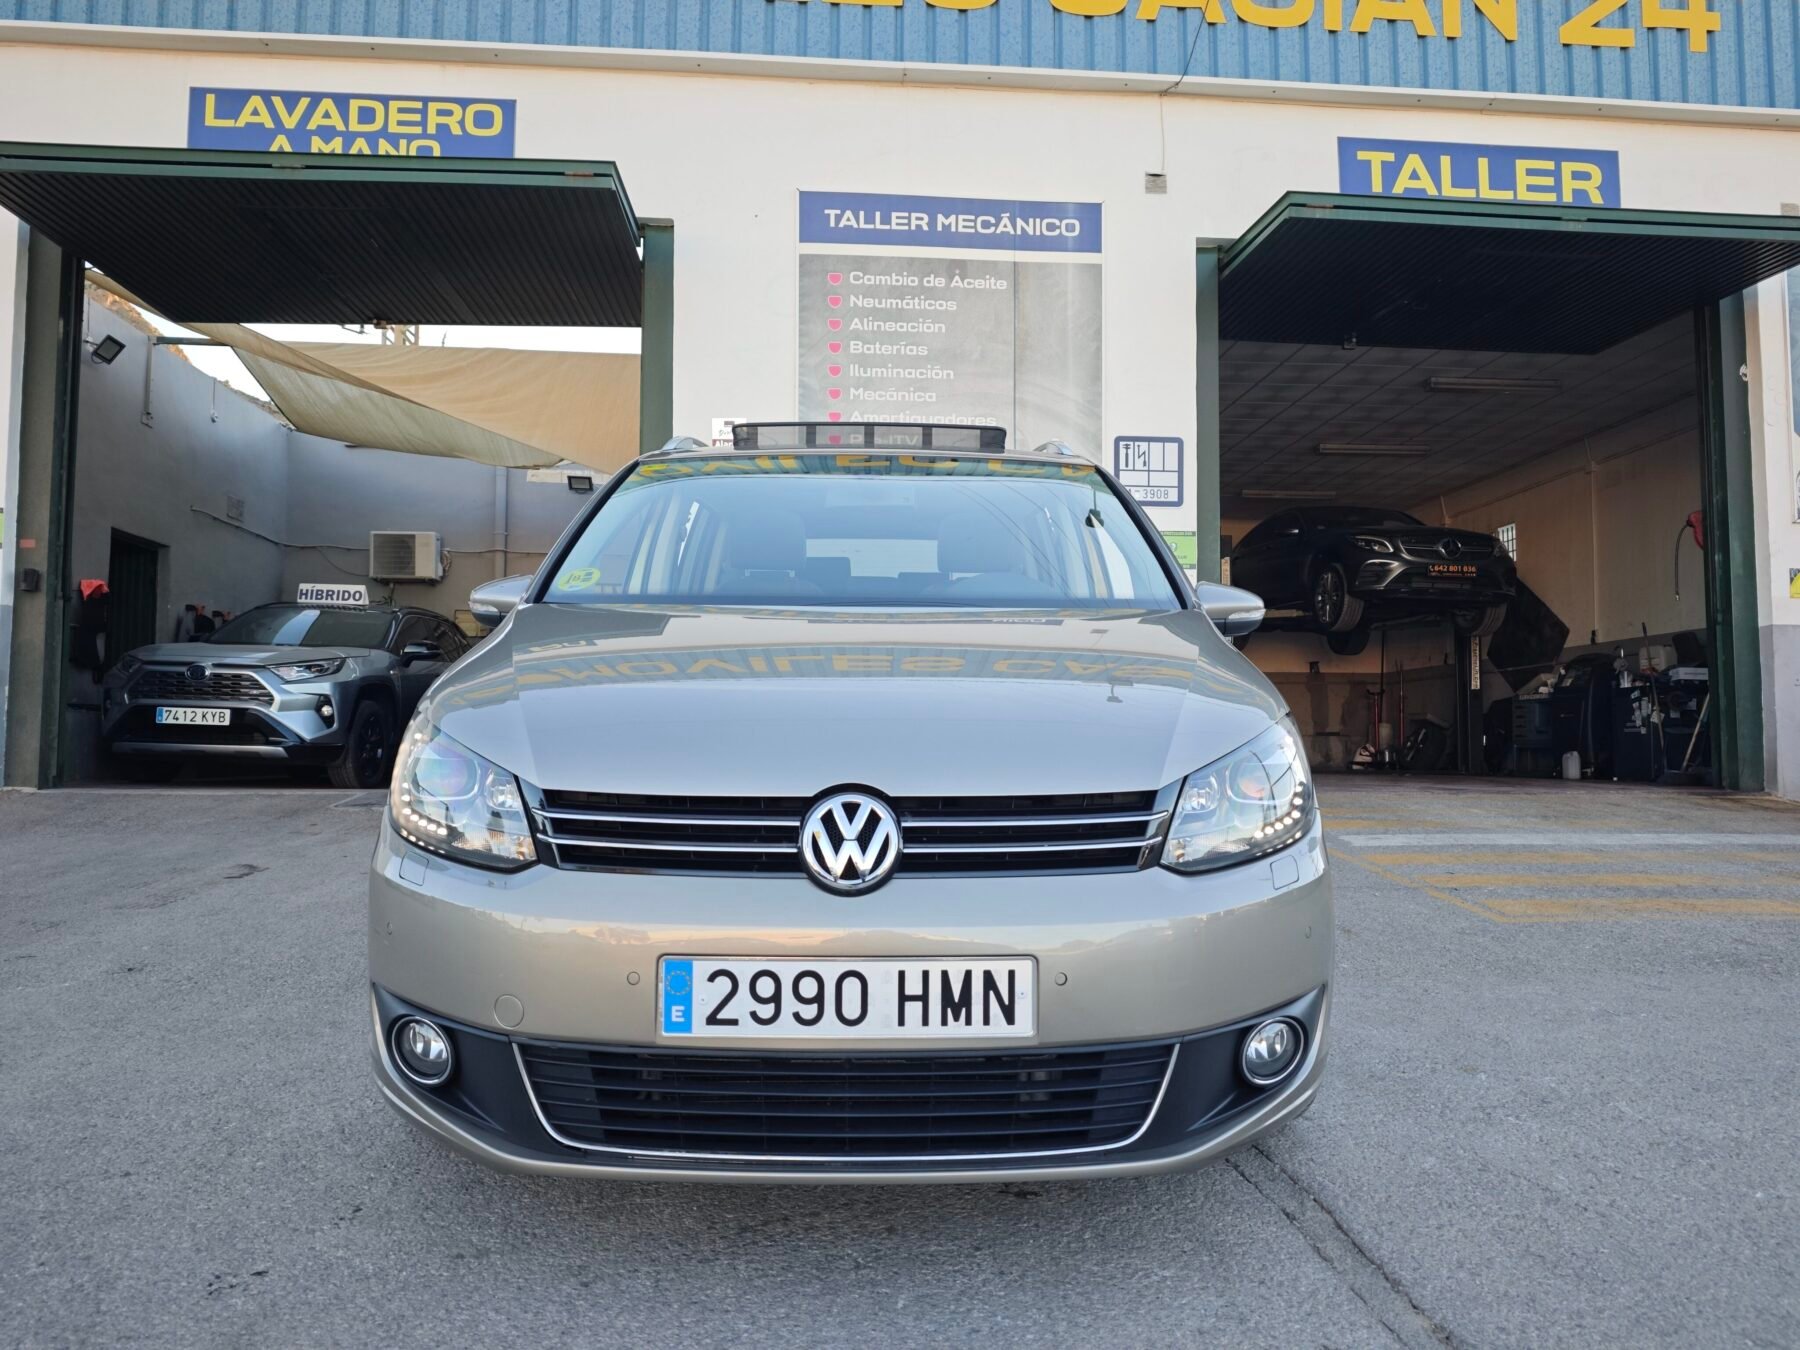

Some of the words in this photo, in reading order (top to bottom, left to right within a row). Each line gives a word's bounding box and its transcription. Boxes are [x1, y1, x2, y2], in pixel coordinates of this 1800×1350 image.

[1559, 0, 1721, 52] 24
[205, 93, 503, 137] LAVADERO
[310, 135, 441, 157] MANO
[1356, 150, 1604, 204] TALLER
[824, 209, 929, 231] TALLER
[937, 212, 1081, 237] MECÁNICO
[849, 271, 919, 287] Cambio
[923, 273, 946, 288] de
[849, 294, 958, 311] Neumáticos
[849, 316, 946, 333] Alineación
[849, 340, 929, 356] Baterías
[850, 363, 955, 380] Iluminación
[849, 386, 937, 402] Mecánica
[299, 585, 363, 602] HÍBRIDO
[165, 709, 198, 723] 7412
[201, 711, 226, 723] KYB
[705, 968, 869, 1026] 2990
[897, 968, 1016, 1026] HMN
[671, 1005, 685, 1022] E
